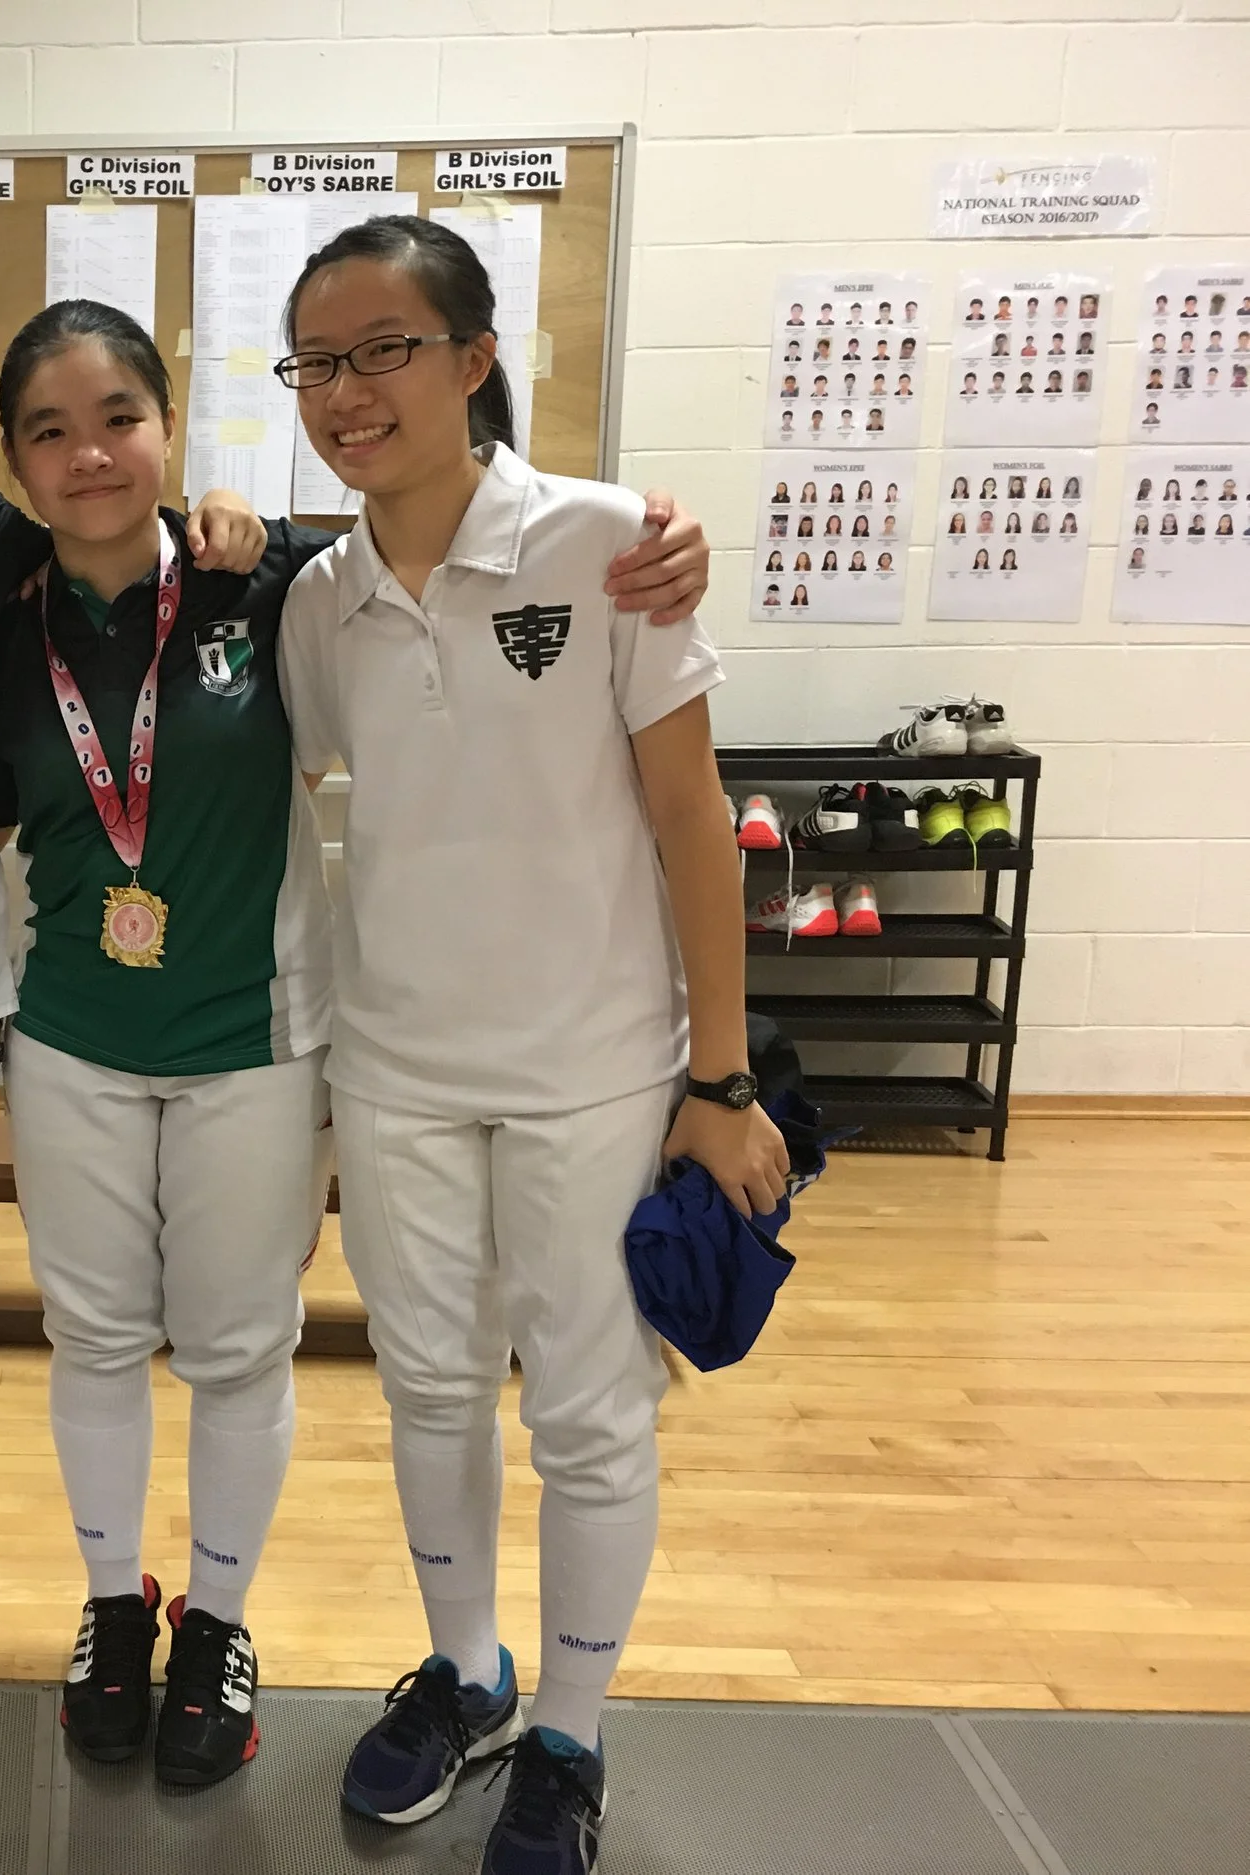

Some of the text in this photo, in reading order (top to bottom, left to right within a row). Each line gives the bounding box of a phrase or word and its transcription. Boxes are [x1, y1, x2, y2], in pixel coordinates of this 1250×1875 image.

[79, 156, 181, 174] C Division
[273, 154, 375, 171] B Division
[449, 150, 552, 168] B Division
[144, 179, 191, 195] FOIL
[322, 176, 393, 192] SABRE
[436, 171, 563, 190] GIRL'S FOIL
[943, 194, 1140, 210] NATIONAL TRAINING SQUAD
[982, 212, 1034, 225] (SEASON
[558, 1633, 617, 1653] uhlmann
